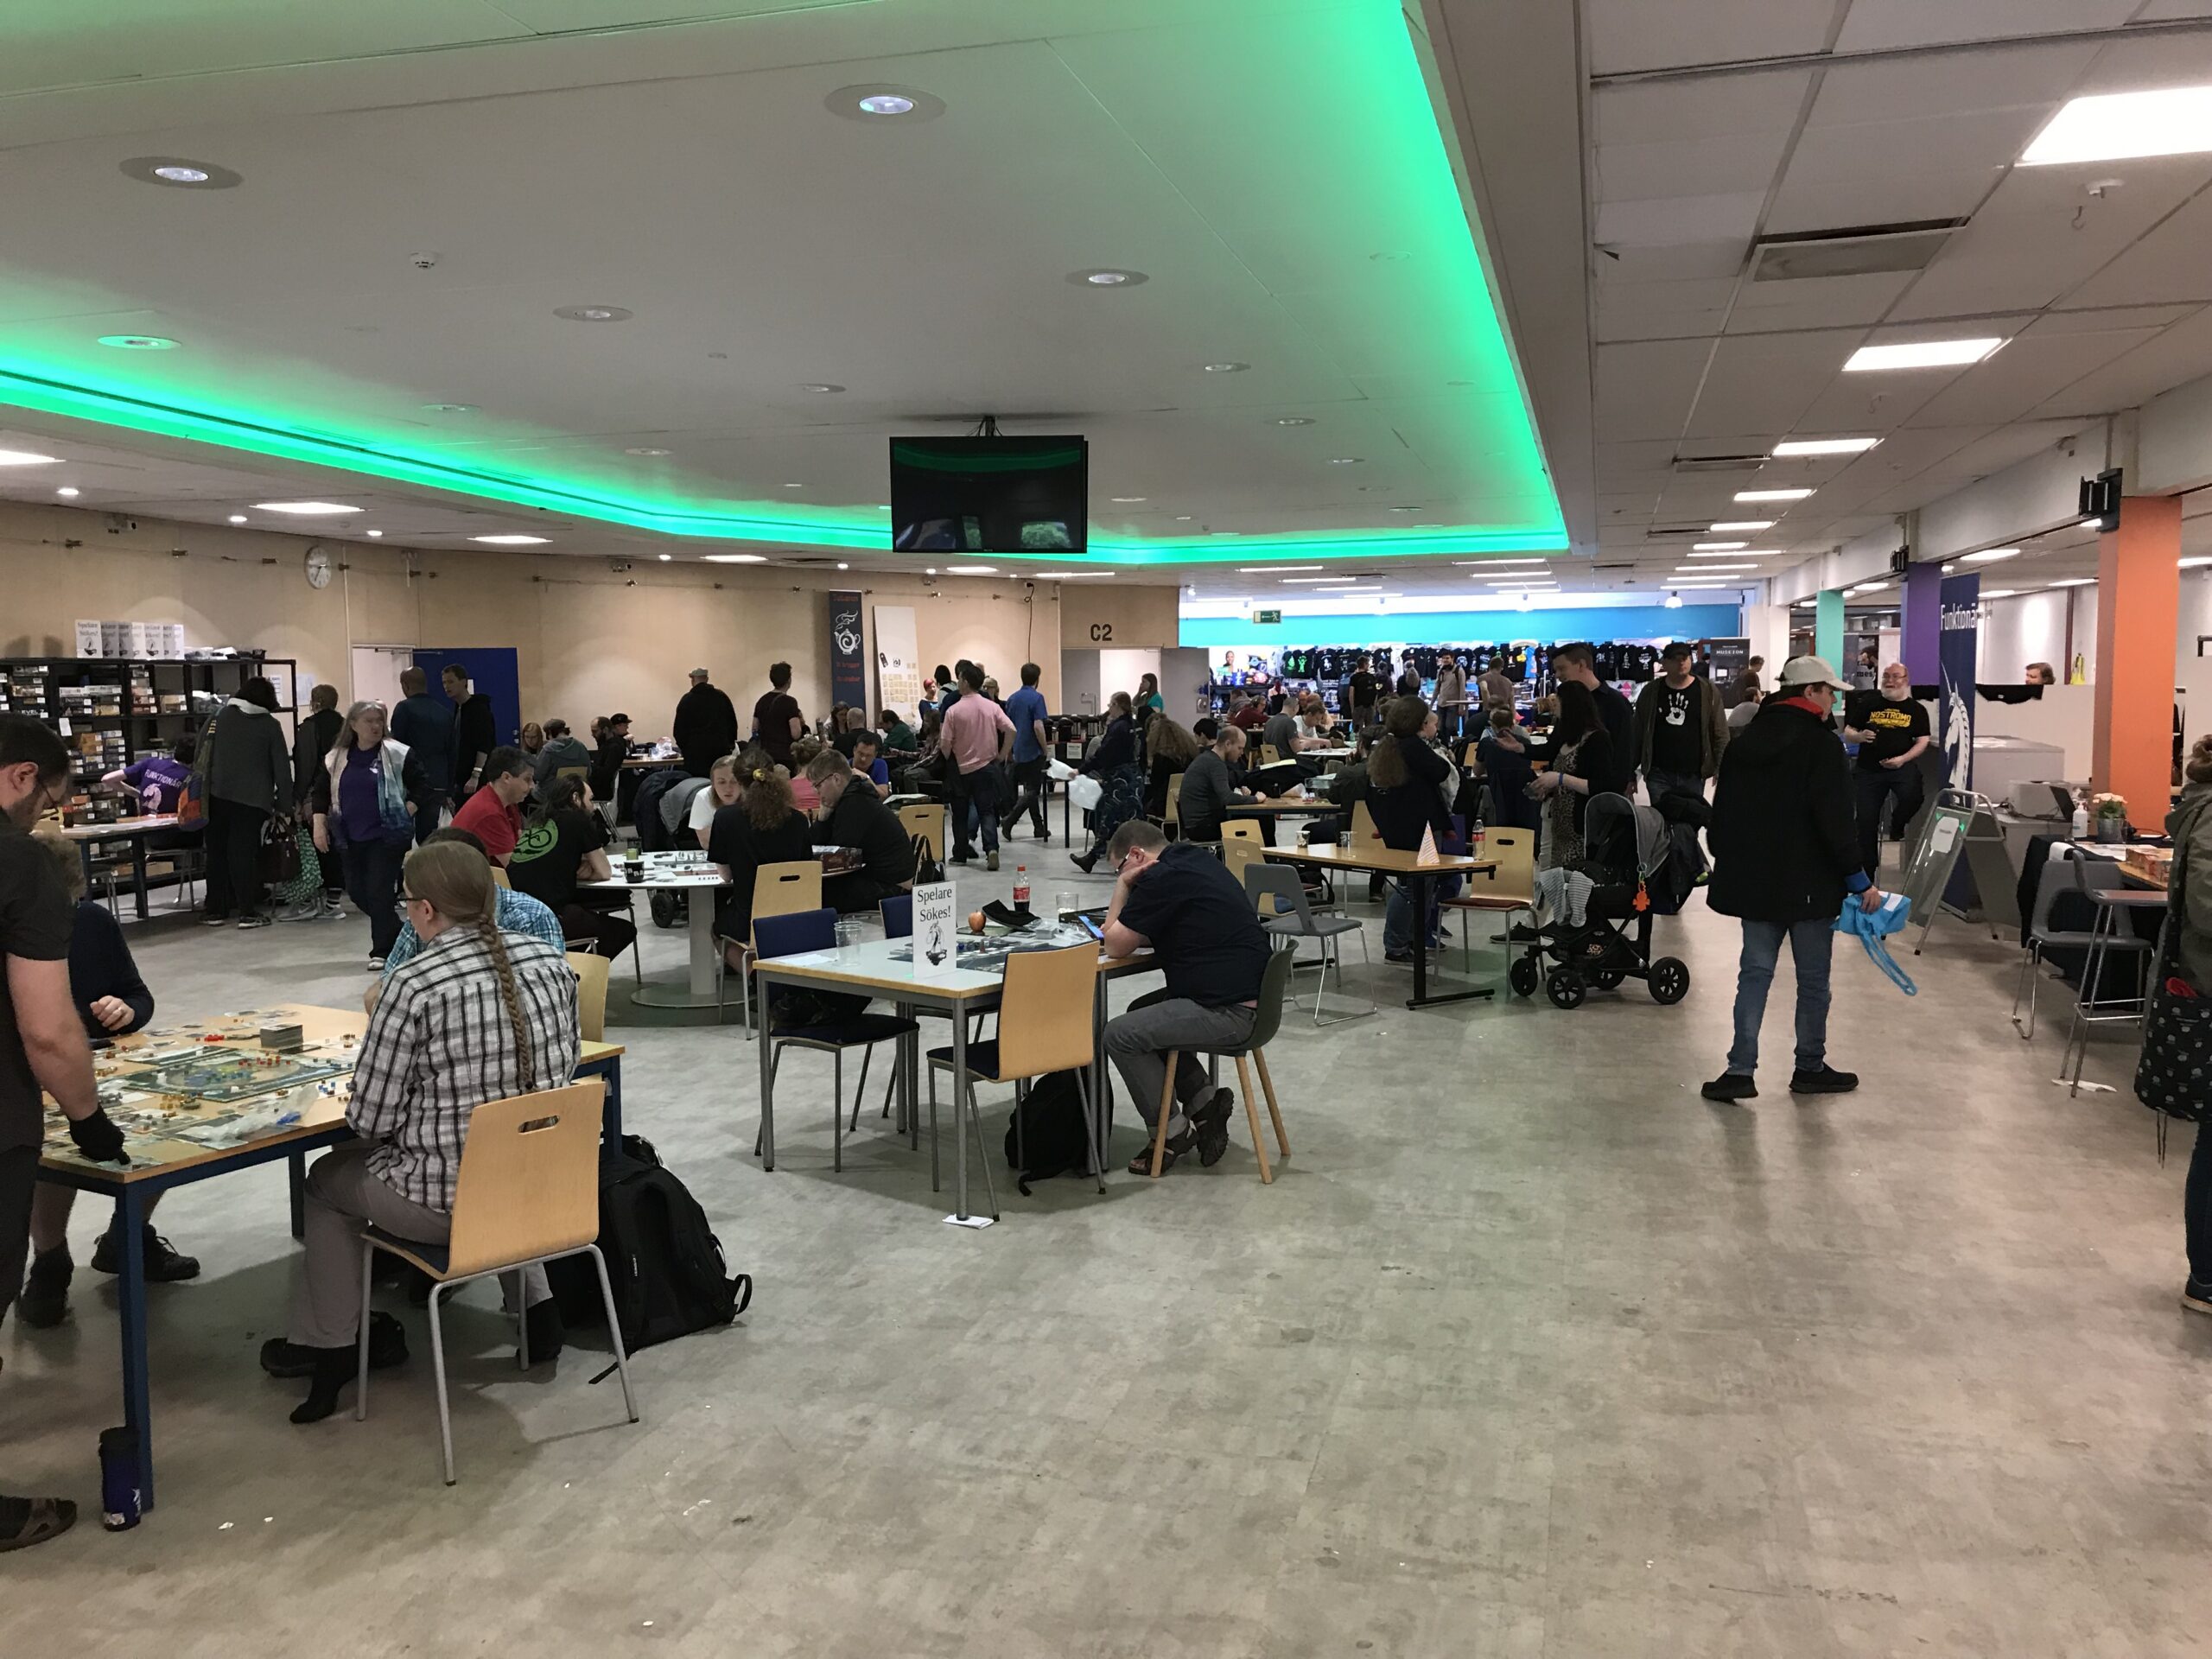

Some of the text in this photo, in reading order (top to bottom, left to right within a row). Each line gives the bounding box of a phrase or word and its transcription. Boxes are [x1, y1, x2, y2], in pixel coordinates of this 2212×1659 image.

[1090, 623, 1112, 641] C2
[1869, 711, 1911, 721] NOSTROMO
[917, 887, 953, 905] Spelare
[919, 905, 951, 922] Sökes!
